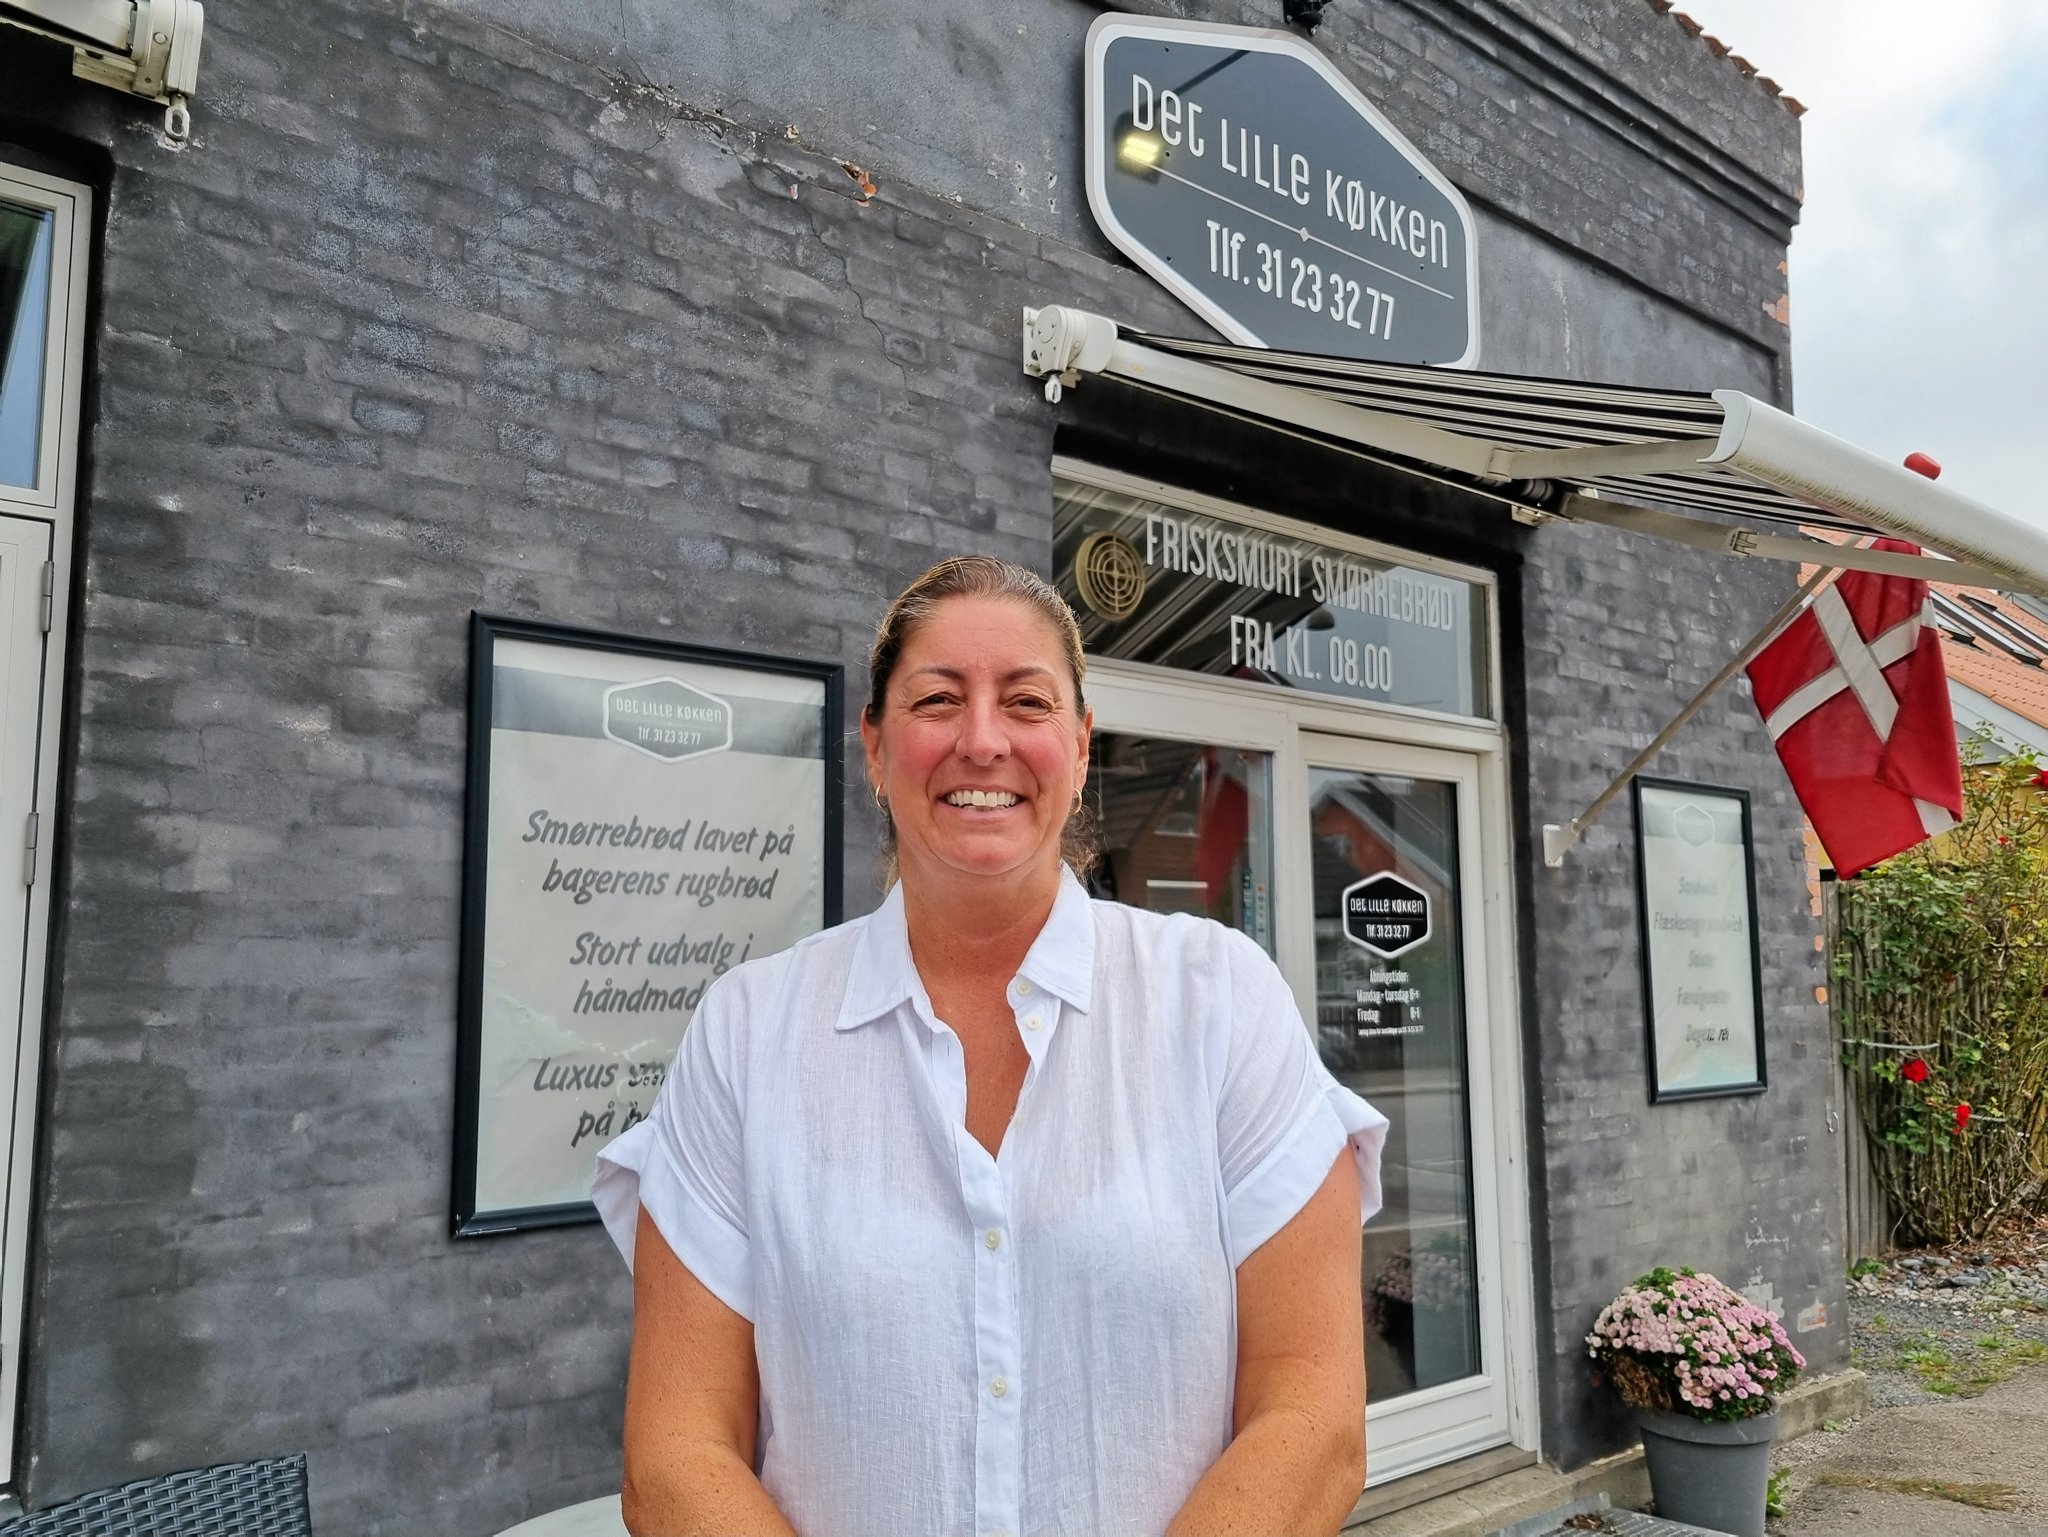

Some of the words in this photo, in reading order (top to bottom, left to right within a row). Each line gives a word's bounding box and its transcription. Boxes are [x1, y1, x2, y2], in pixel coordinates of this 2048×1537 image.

[1206, 219, 1250, 287] Tlf.
[1257, 242, 1283, 299] 31
[1290, 257, 1322, 314] 23
[1329, 273, 1362, 331] 32
[1366, 286, 1395, 341] 77
[1145, 512, 1301, 598] FRISKSMURT
[1312, 555, 1452, 631] SMØRREBRØD
[1230, 614, 1277, 672] FRA
[1286, 626, 1321, 680] KL.
[1329, 635, 1392, 692] 08.00
[654, 728, 663, 742] 31
[665, 729, 676, 743] 23
[678, 731, 688, 745] 32
[691, 732, 701, 745] 77
[522, 809, 692, 852] Smørrebrød
[694, 820, 758, 854] lavet
[759, 824, 795, 862] på
[542, 858, 670, 905] bagerens
[675, 866, 779, 907] rugbrød
[569, 931, 642, 966] Stort
[647, 933, 736, 976] udvalg
[741, 932, 753, 964] i
[572, 978, 706, 1014] håndmad
[533, 1057, 619, 1091] Luxus
[571, 1100, 616, 1148] på
